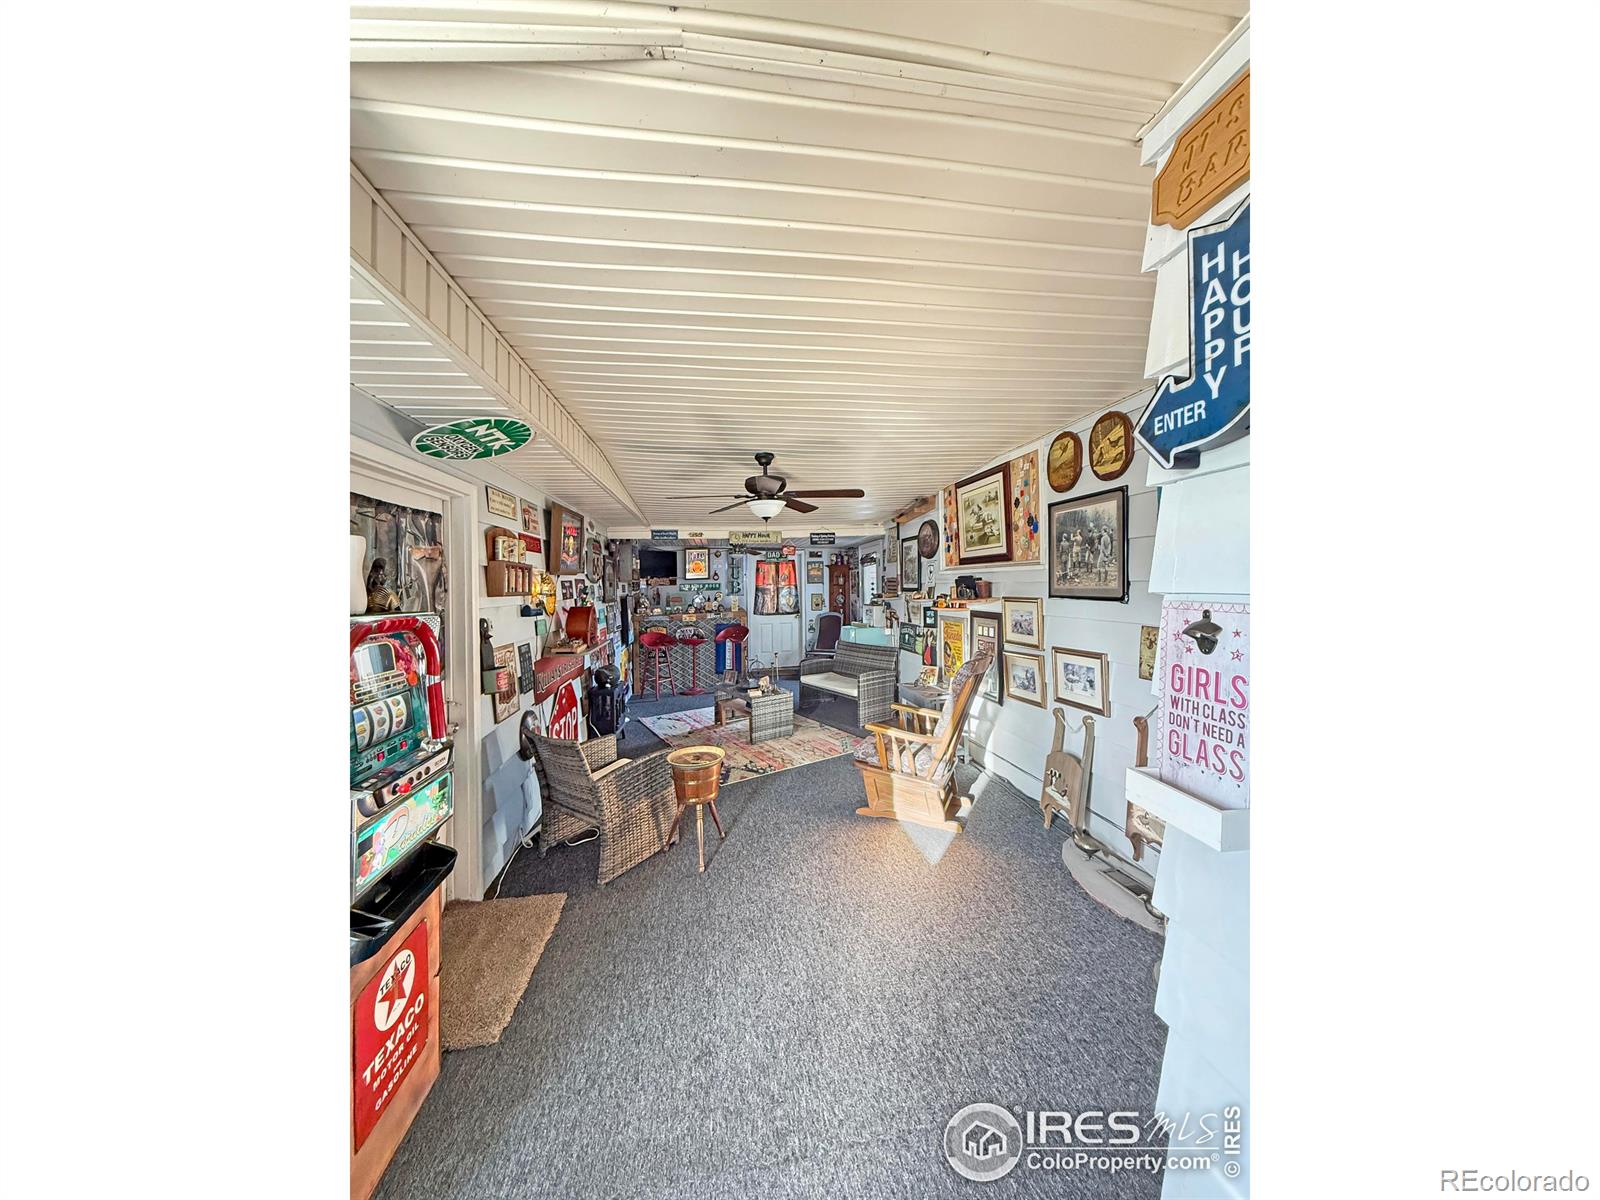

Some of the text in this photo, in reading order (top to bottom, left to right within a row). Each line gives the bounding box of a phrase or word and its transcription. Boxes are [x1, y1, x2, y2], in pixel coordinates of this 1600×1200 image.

[1176, 129, 1247, 208] BAR
[1201, 241, 1228, 400] HAPPY
[464, 423, 516, 450] NTK
[1153, 400, 1207, 437] ENTER
[1170, 663, 1249, 711] GIRLS
[553, 706, 577, 740] STOP
[1168, 711, 1245, 749] DON'T NEED A
[1169, 694, 1246, 730] WITH CLASS
[1168, 728, 1246, 783] GLASS
[379, 953, 412, 996] TEXACO
[362, 992, 425, 1087] TEXACO
[372, 1022, 420, 1092] MOTOR OIL
[375, 1043, 419, 1111] GASOLINE
